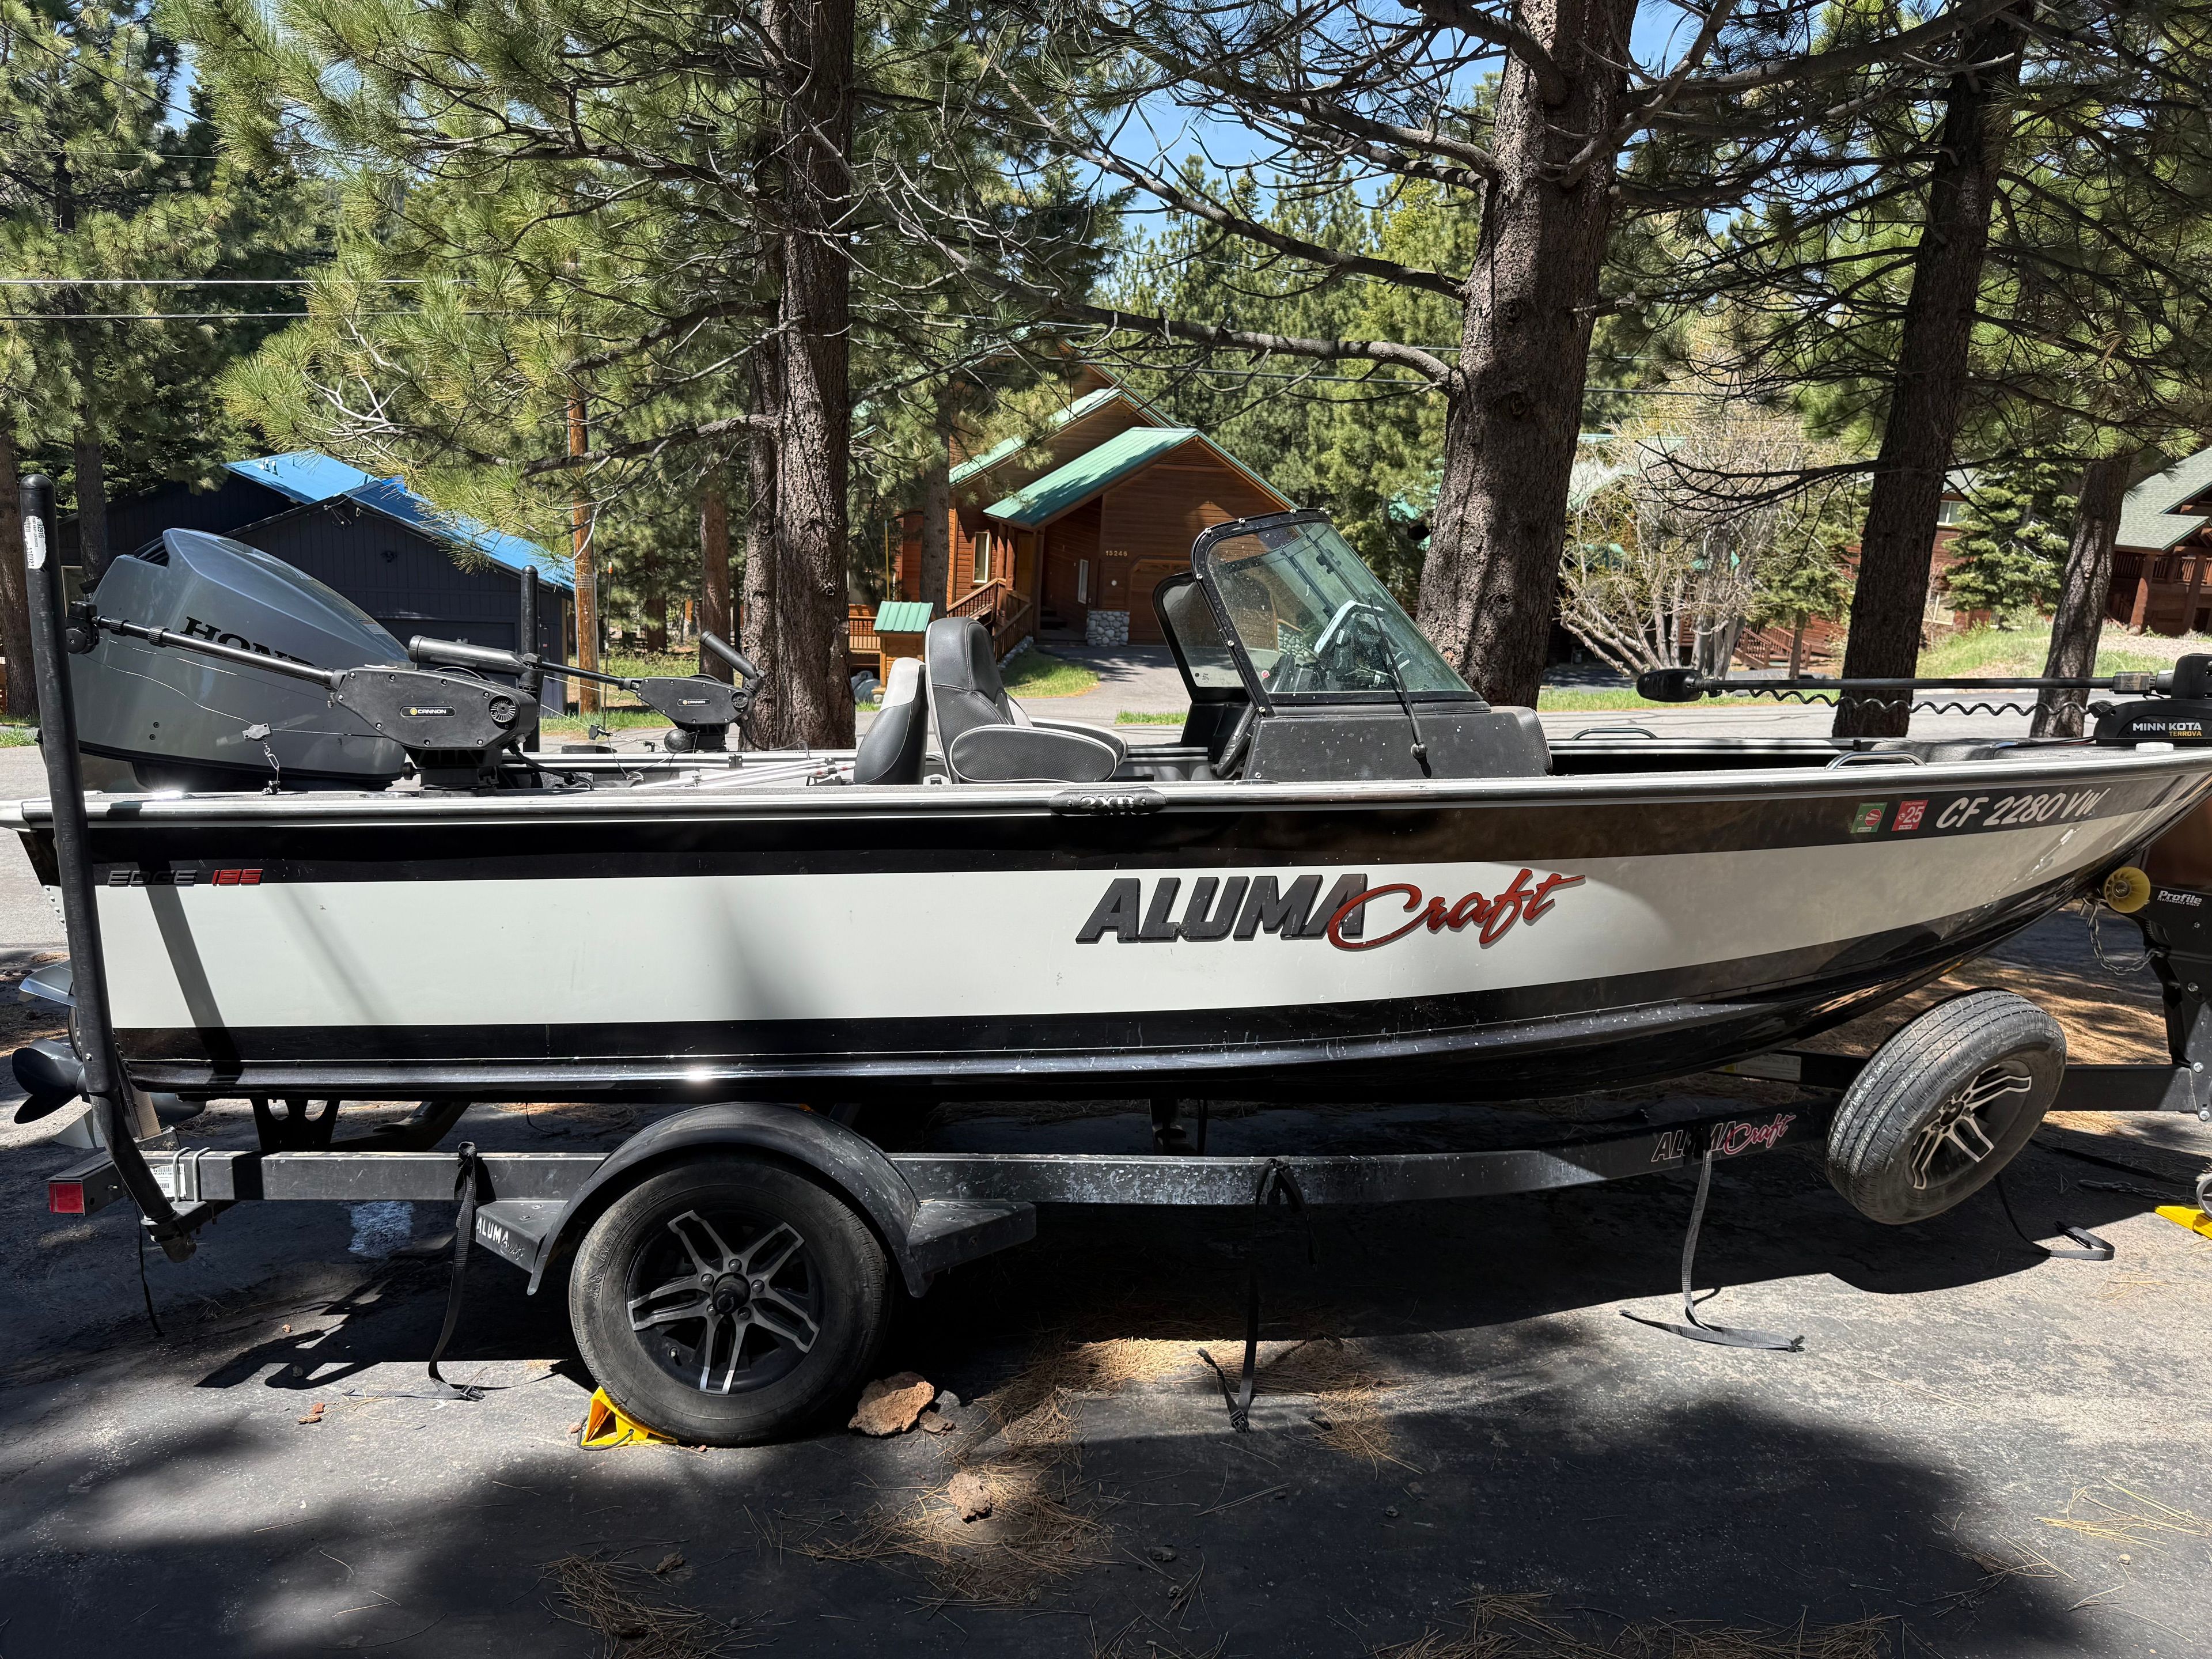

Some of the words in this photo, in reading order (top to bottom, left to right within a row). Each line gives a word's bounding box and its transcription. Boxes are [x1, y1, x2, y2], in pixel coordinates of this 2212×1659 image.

[2133, 722, 2166, 731] MINN
[2168, 722, 2202, 730] KOTA
[1903, 806, 1925, 823] 25
[1936, 797, 1990, 828] CF
[1983, 793, 2067, 826] 2280
[107, 870, 198, 886] EDGE
[211, 869, 263, 885] 185
[2158, 890, 2202, 904] Profile
